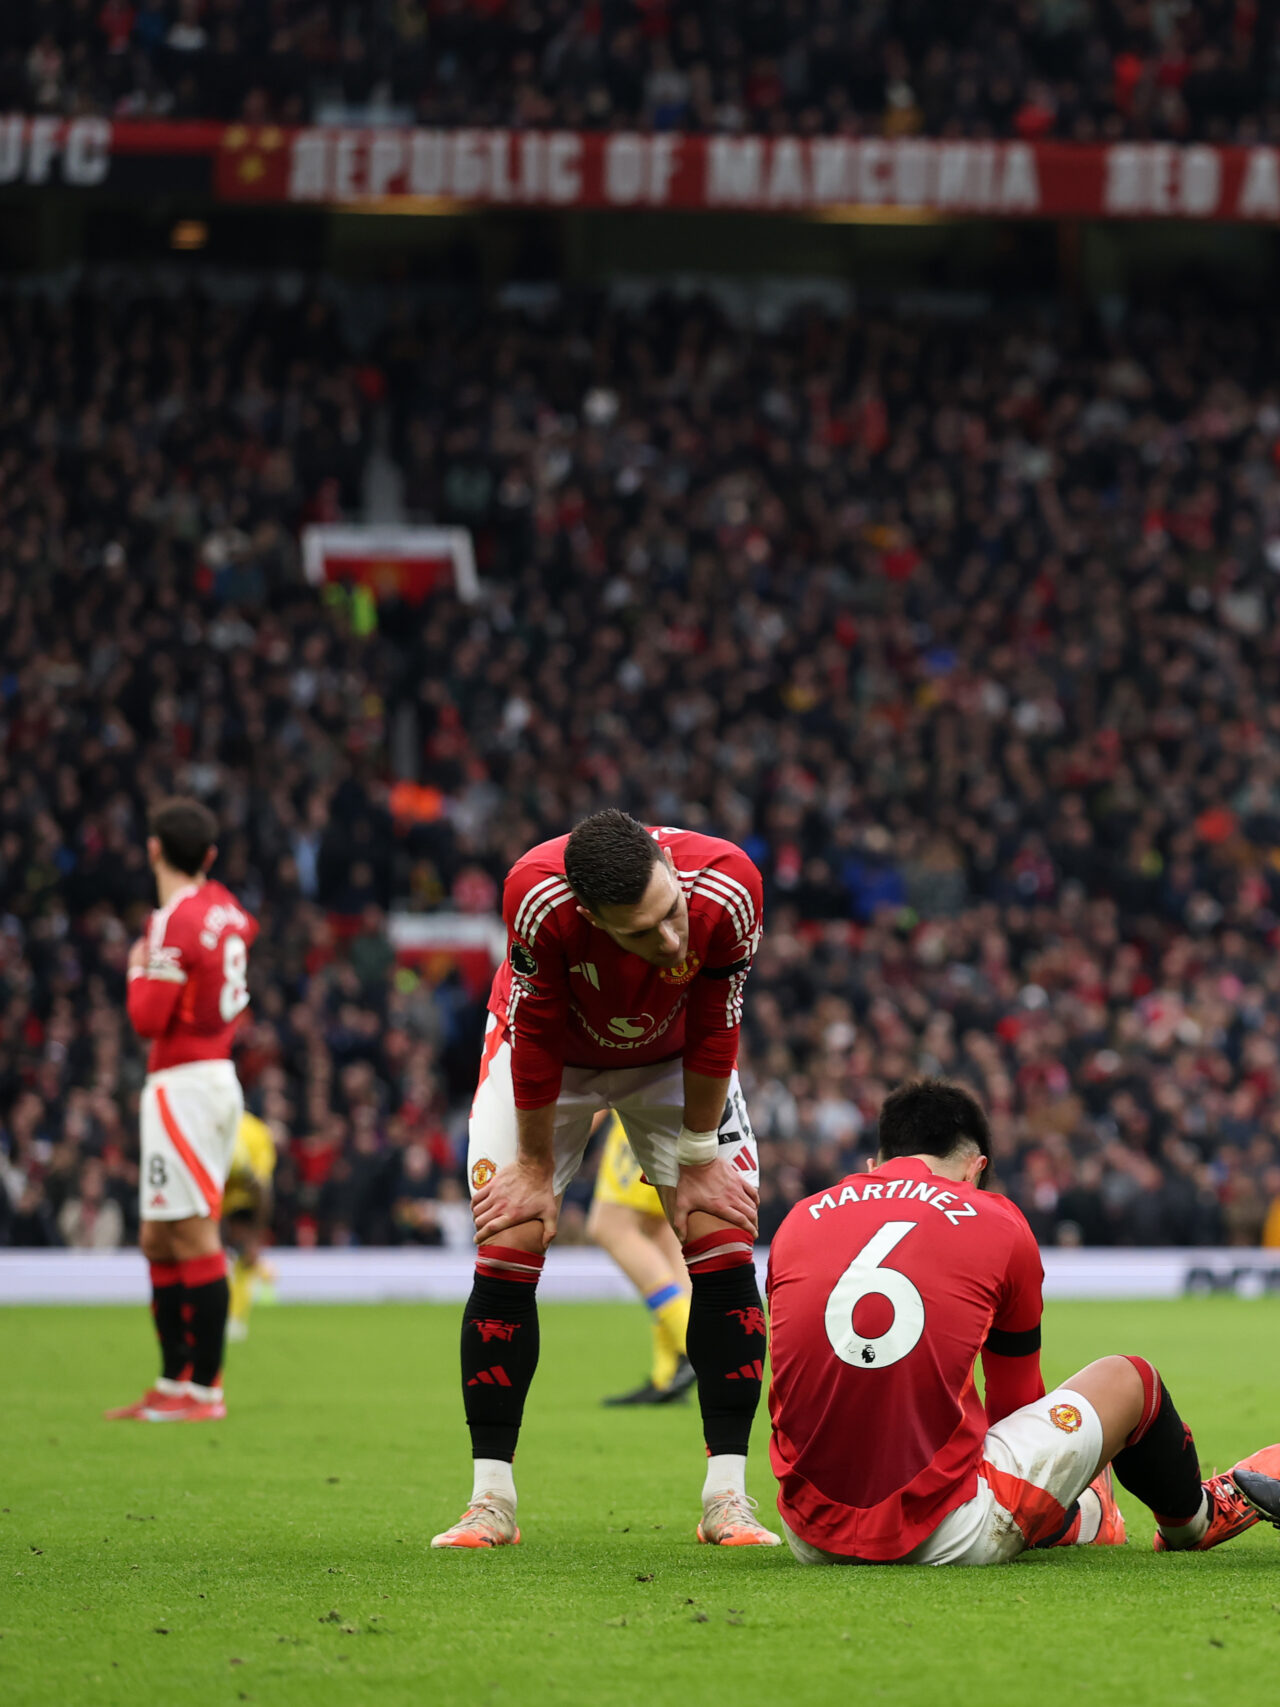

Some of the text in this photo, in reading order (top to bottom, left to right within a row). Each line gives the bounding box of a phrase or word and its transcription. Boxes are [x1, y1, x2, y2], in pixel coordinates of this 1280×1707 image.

[289, 131, 583, 205] REPUBLIC
[606, 134, 681, 206] OF
[1104, 145, 1222, 215] RED
[219, 932, 250, 1023] 8
[149, 1153, 167, 1187] 8
[808, 1179, 978, 1226] MARTINEZ
[824, 1221, 926, 1369] 6
